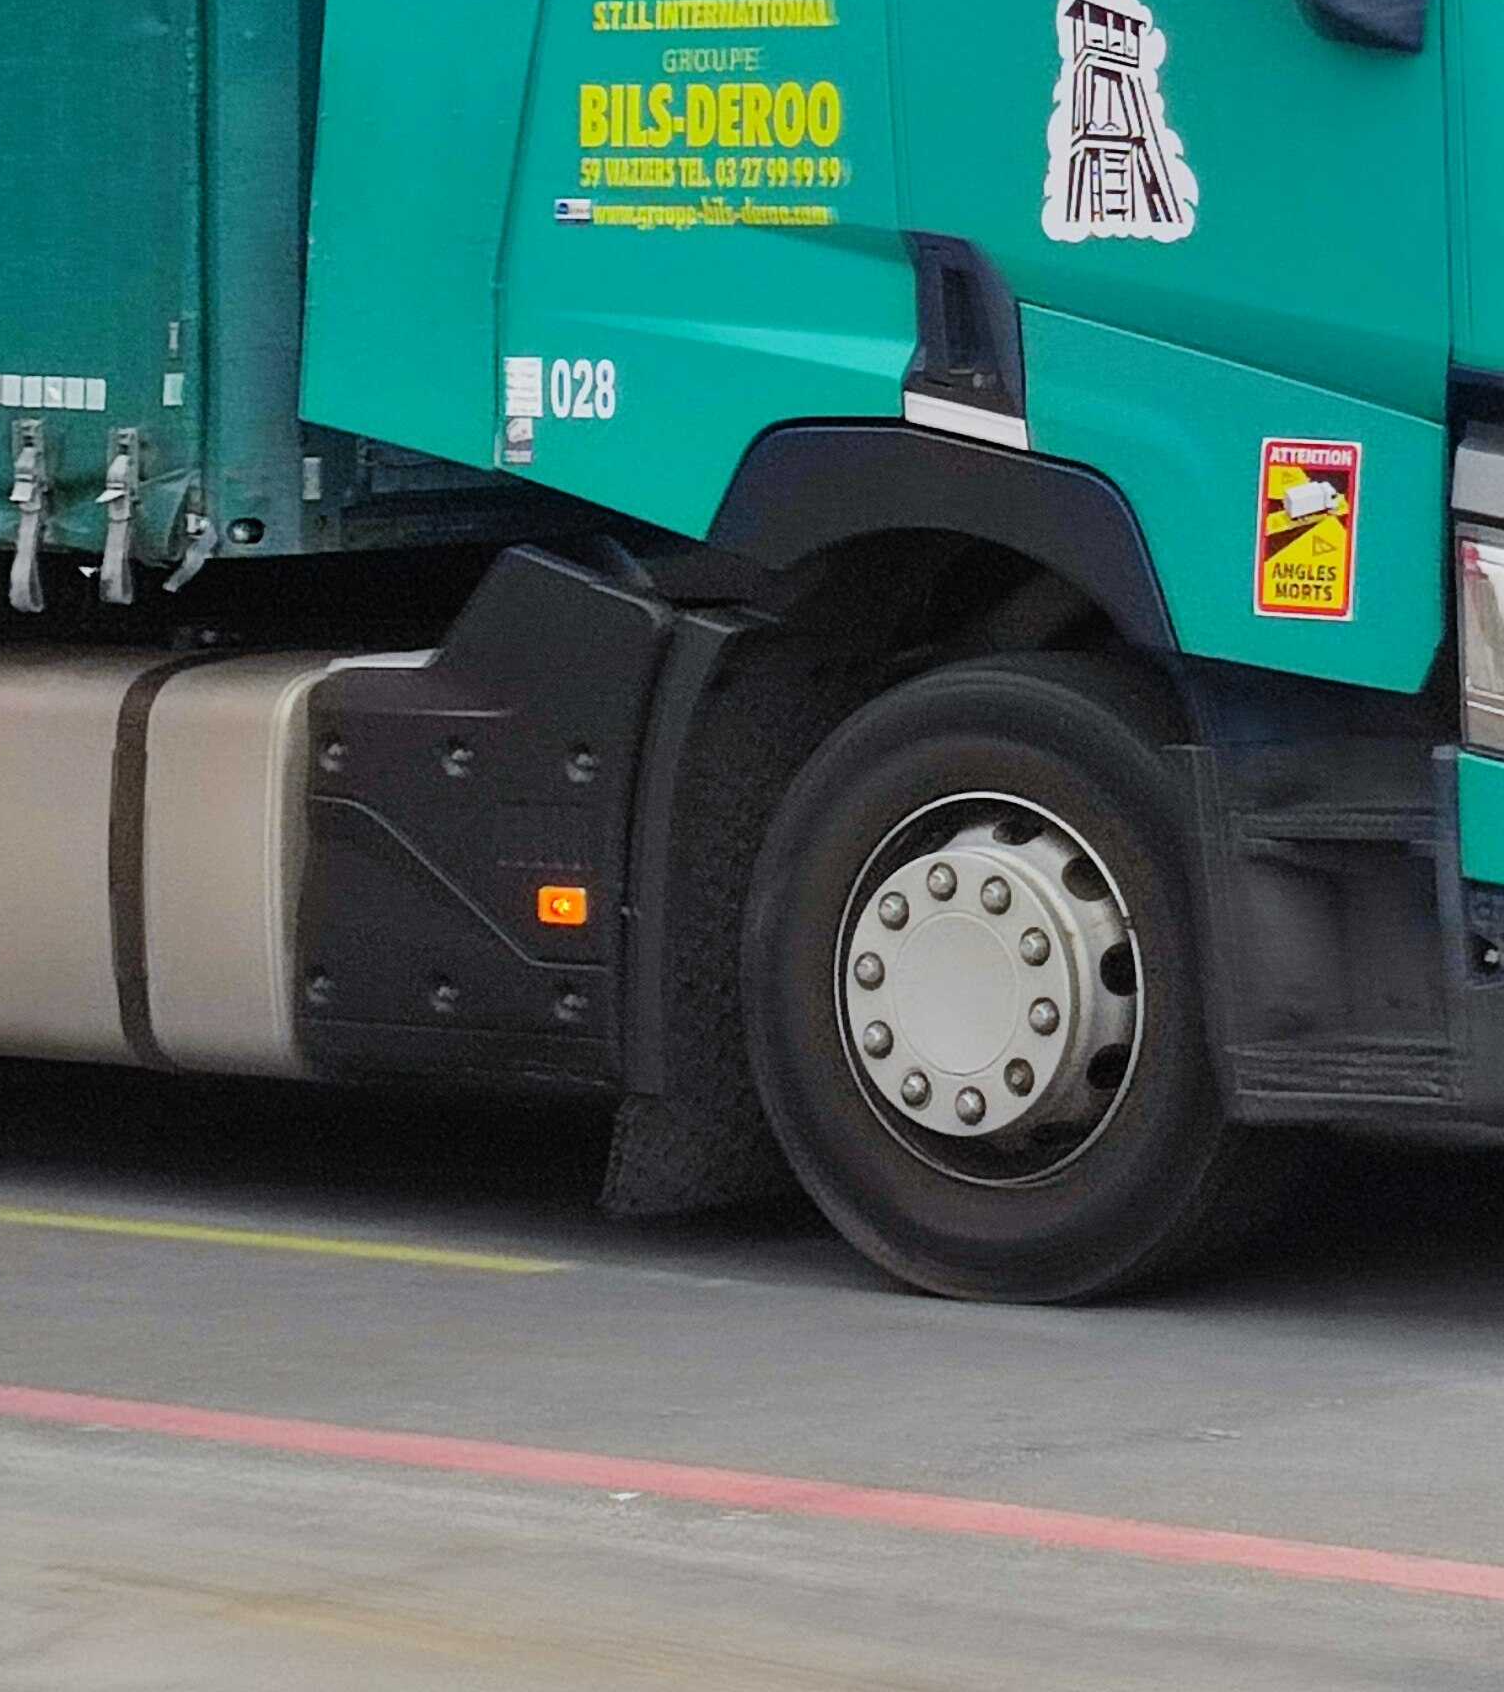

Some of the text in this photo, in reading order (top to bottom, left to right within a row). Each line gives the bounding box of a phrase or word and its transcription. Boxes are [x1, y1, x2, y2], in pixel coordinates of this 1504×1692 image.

[662, 47, 761, 73] GROUPE
[580, 80, 841, 148] BILS-DEROO
[715, 157, 736, 188] 03
[740, 157, 763, 188] 27
[551, 358, 616, 419] 028
[1269, 446, 1353, 466] ATTENTION
[1272, 563, 1337, 581] ANGLES
[1275, 583, 1333, 602] MORTS
